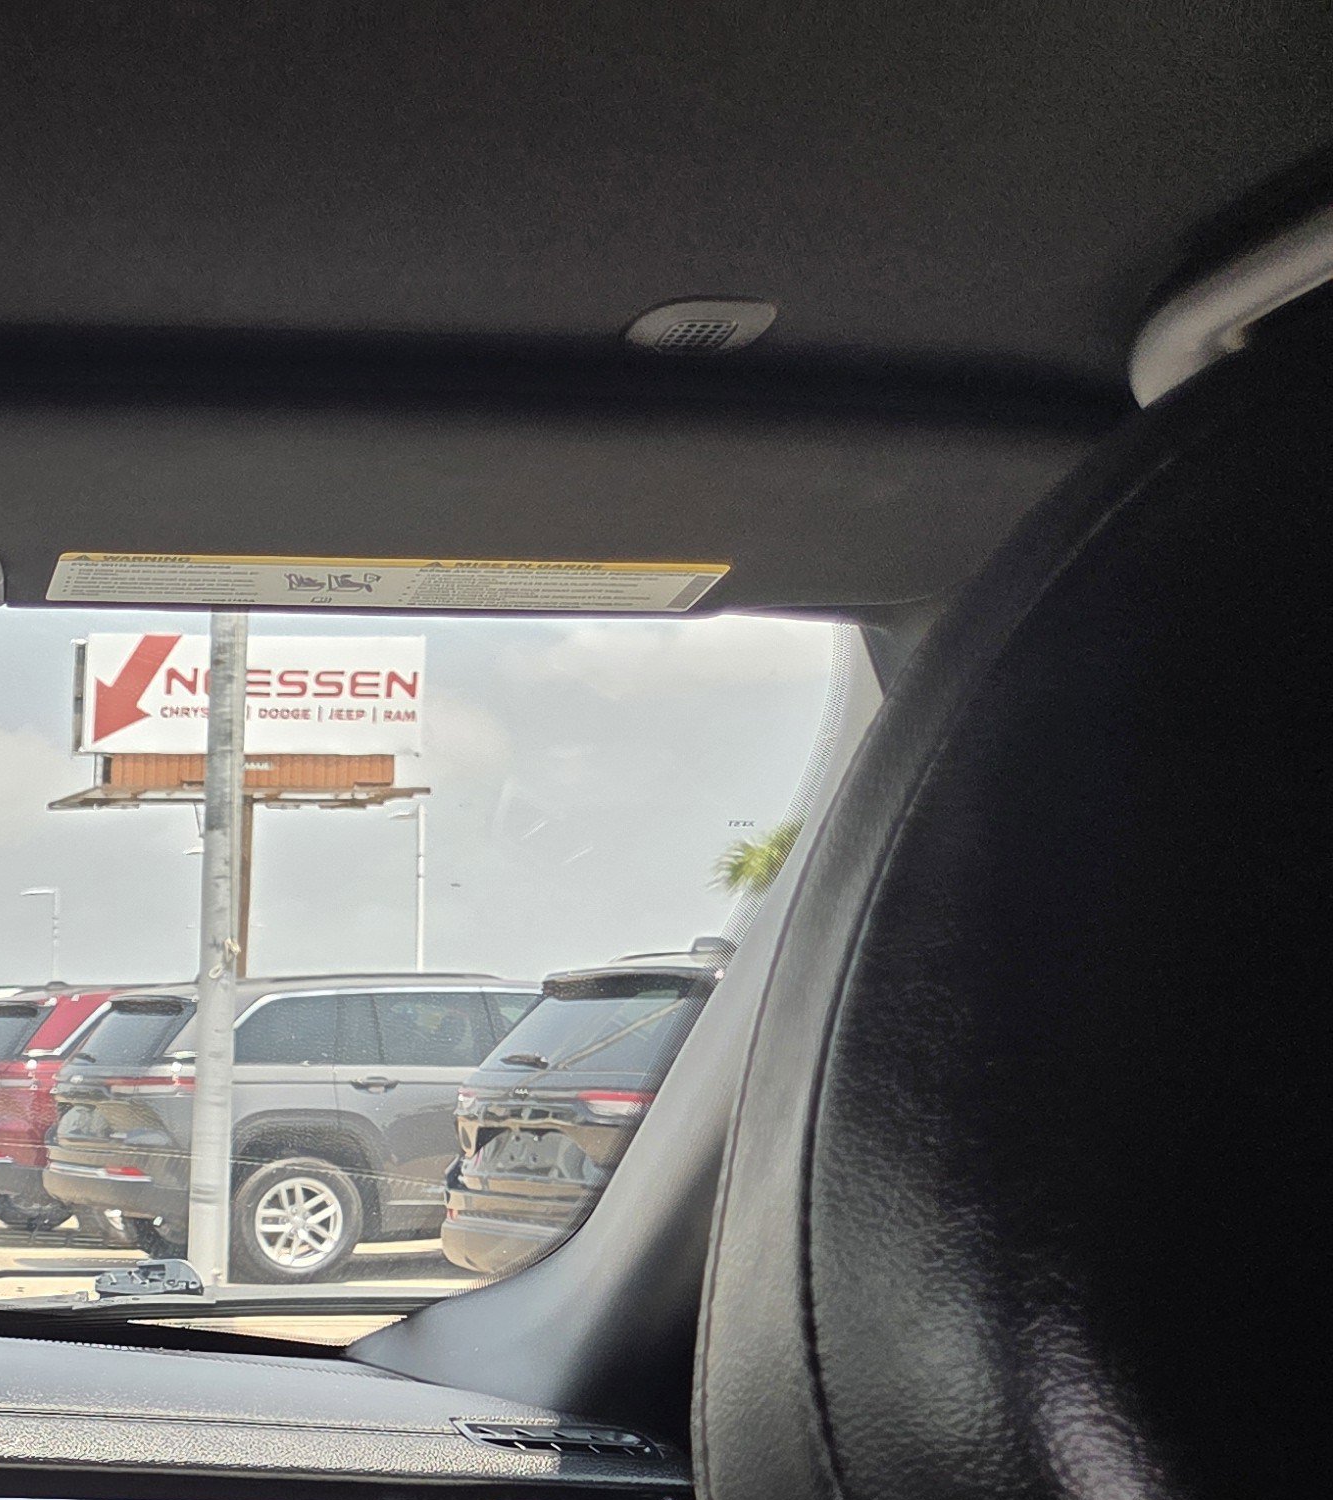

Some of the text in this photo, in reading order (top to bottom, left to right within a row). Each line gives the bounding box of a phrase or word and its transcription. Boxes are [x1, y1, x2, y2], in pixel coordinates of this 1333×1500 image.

[102, 555, 192, 564] WARNING
[165, 667, 418, 698] NESSEN
[160, 706, 417, 722] CHRYS DODGE JEEP RAM
